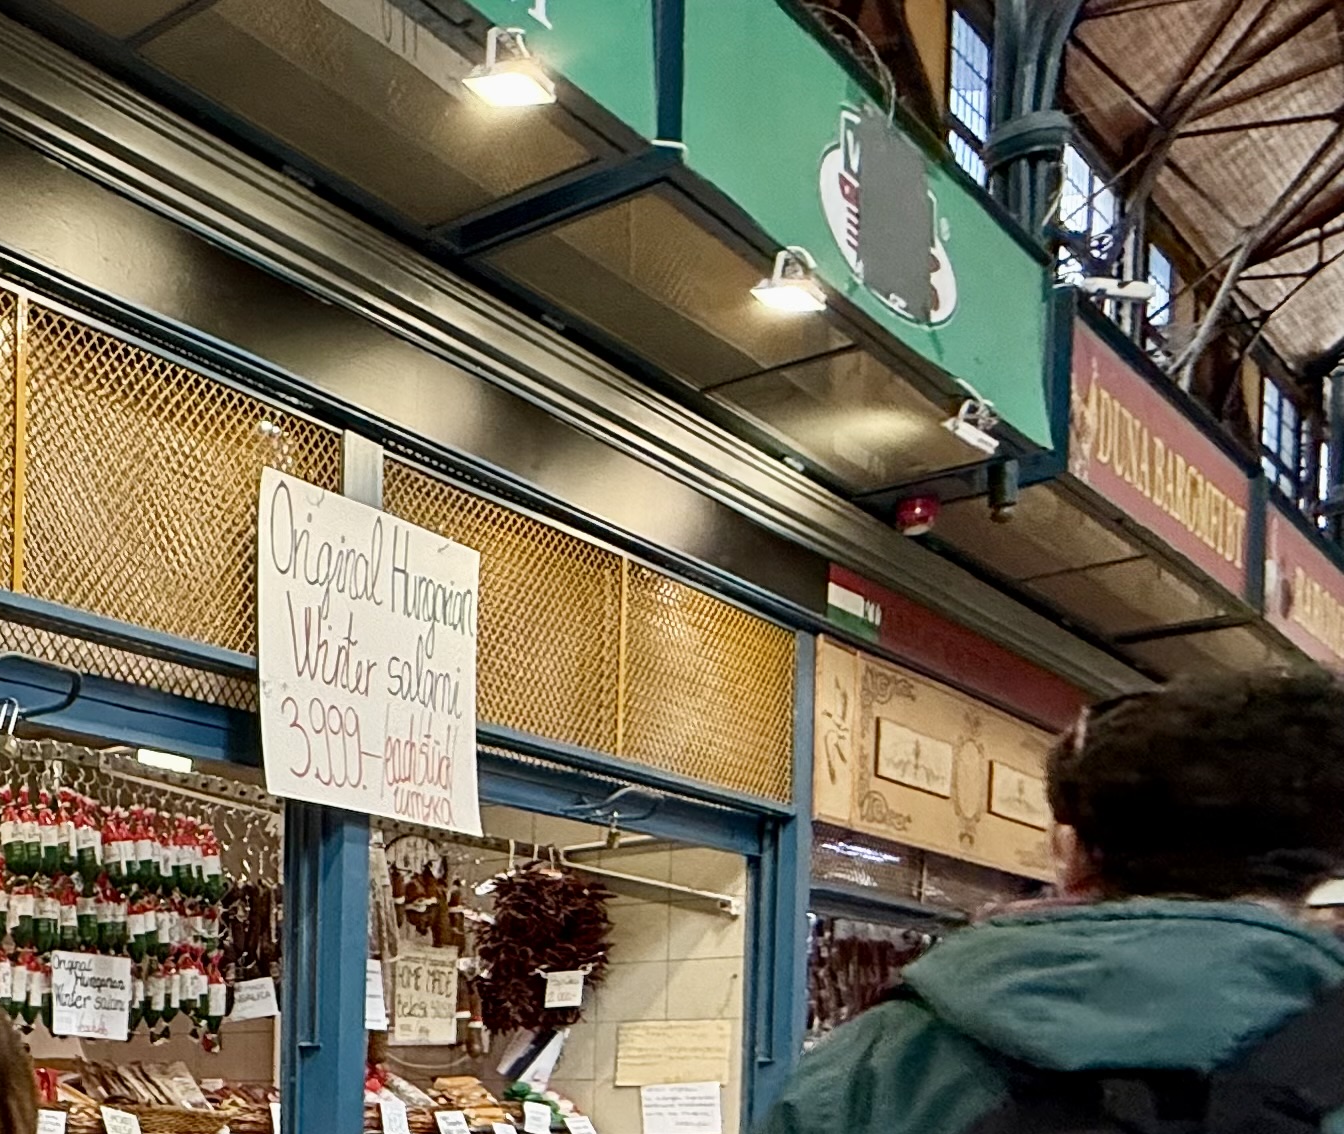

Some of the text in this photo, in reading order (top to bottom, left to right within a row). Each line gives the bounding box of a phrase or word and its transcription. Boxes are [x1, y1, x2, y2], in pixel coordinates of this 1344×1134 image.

[270, 480, 474, 659] Original Hungarian
[287, 590, 463, 720] Winter salami
